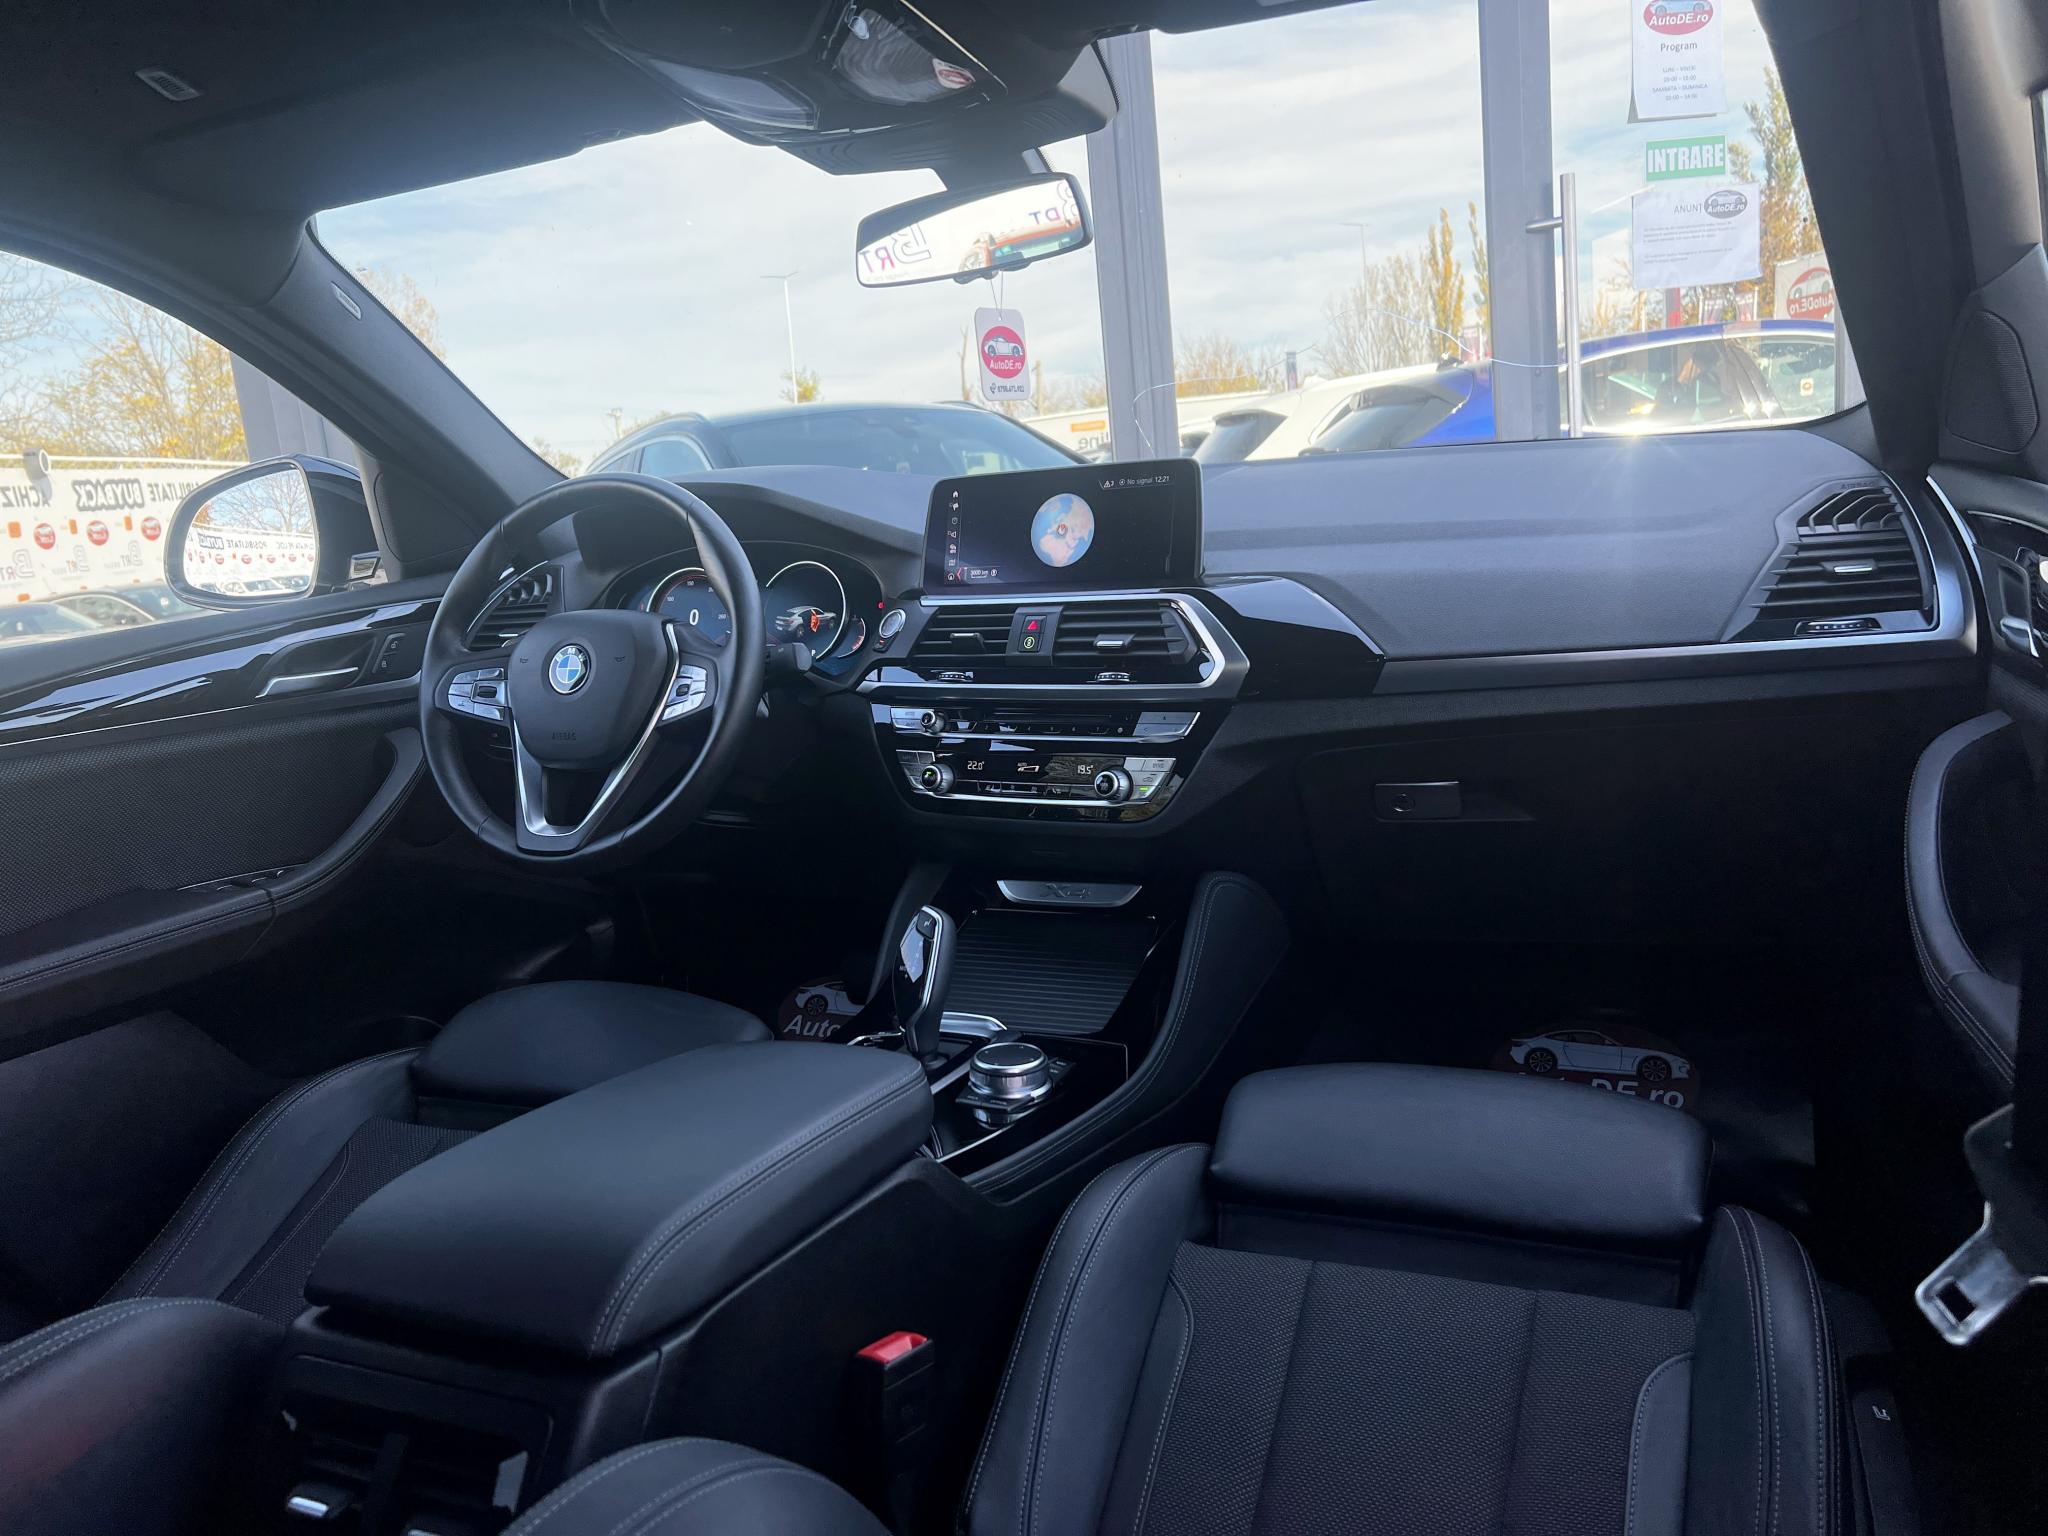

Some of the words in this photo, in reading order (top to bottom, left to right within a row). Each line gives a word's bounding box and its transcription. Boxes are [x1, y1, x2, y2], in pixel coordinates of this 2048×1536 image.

[1648, 12, 1709, 28] AutoDE.ro
[1660, 40, 1698, 53] Program
[1648, 142, 1724, 173] INTRARE
[1707, 201, 1745, 214] AutoDE.ro
[989, 359, 1022, 371] AutoDE.ro
[1136, 477, 1153, 487] signal
[1155, 475, 1170, 484] 12:21
[689, 608, 699, 626] 0
[556, 647, 587, 662] BMW
[811, 649, 816, 657] P
